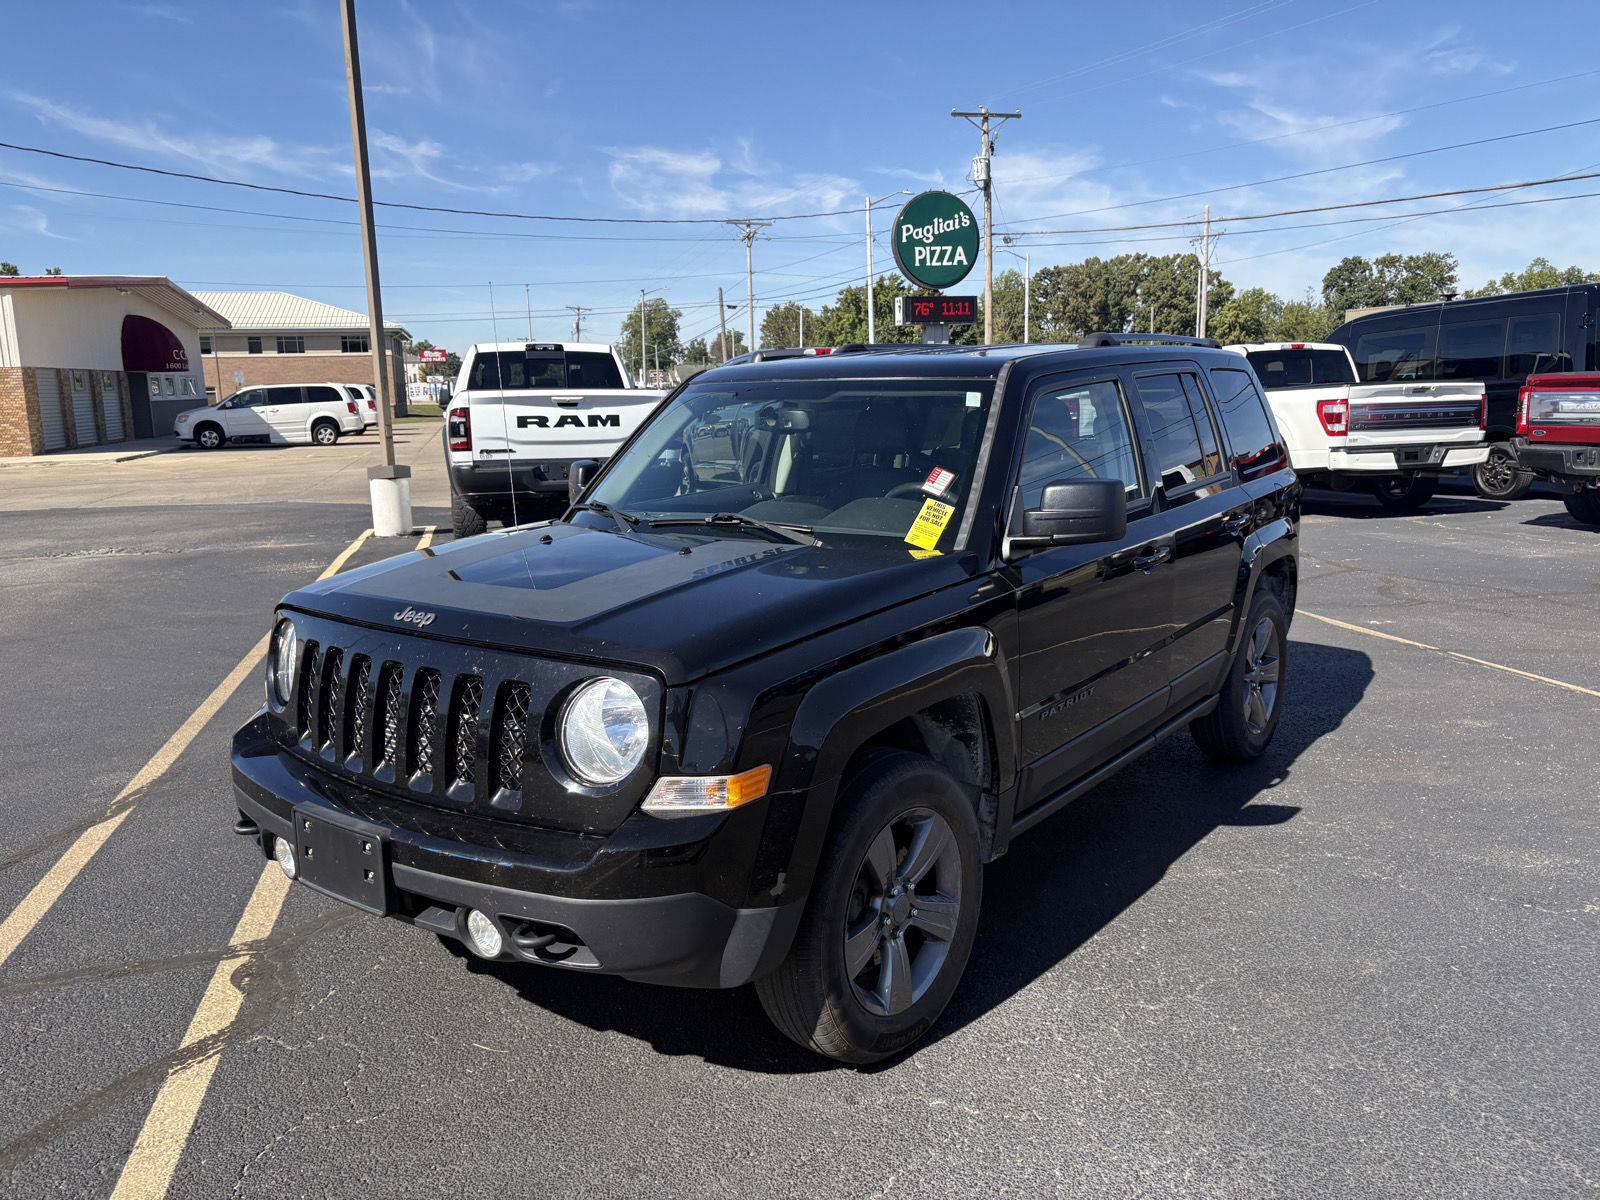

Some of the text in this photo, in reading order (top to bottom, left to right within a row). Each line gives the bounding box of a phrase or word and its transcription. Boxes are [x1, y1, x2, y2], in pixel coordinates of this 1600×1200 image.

[901, 211, 970, 244] Pagliai's
[914, 246, 968, 267] PIZZA
[942, 303, 971, 316] 11:11
[516, 414, 621, 429] RAM
[920, 514, 930, 522] FOR
[926, 505, 948, 516] VEHICLE
[932, 513, 943, 521] NOT
[393, 606, 436, 628] Jeep
[1041, 686, 1096, 721] PATRIOT
